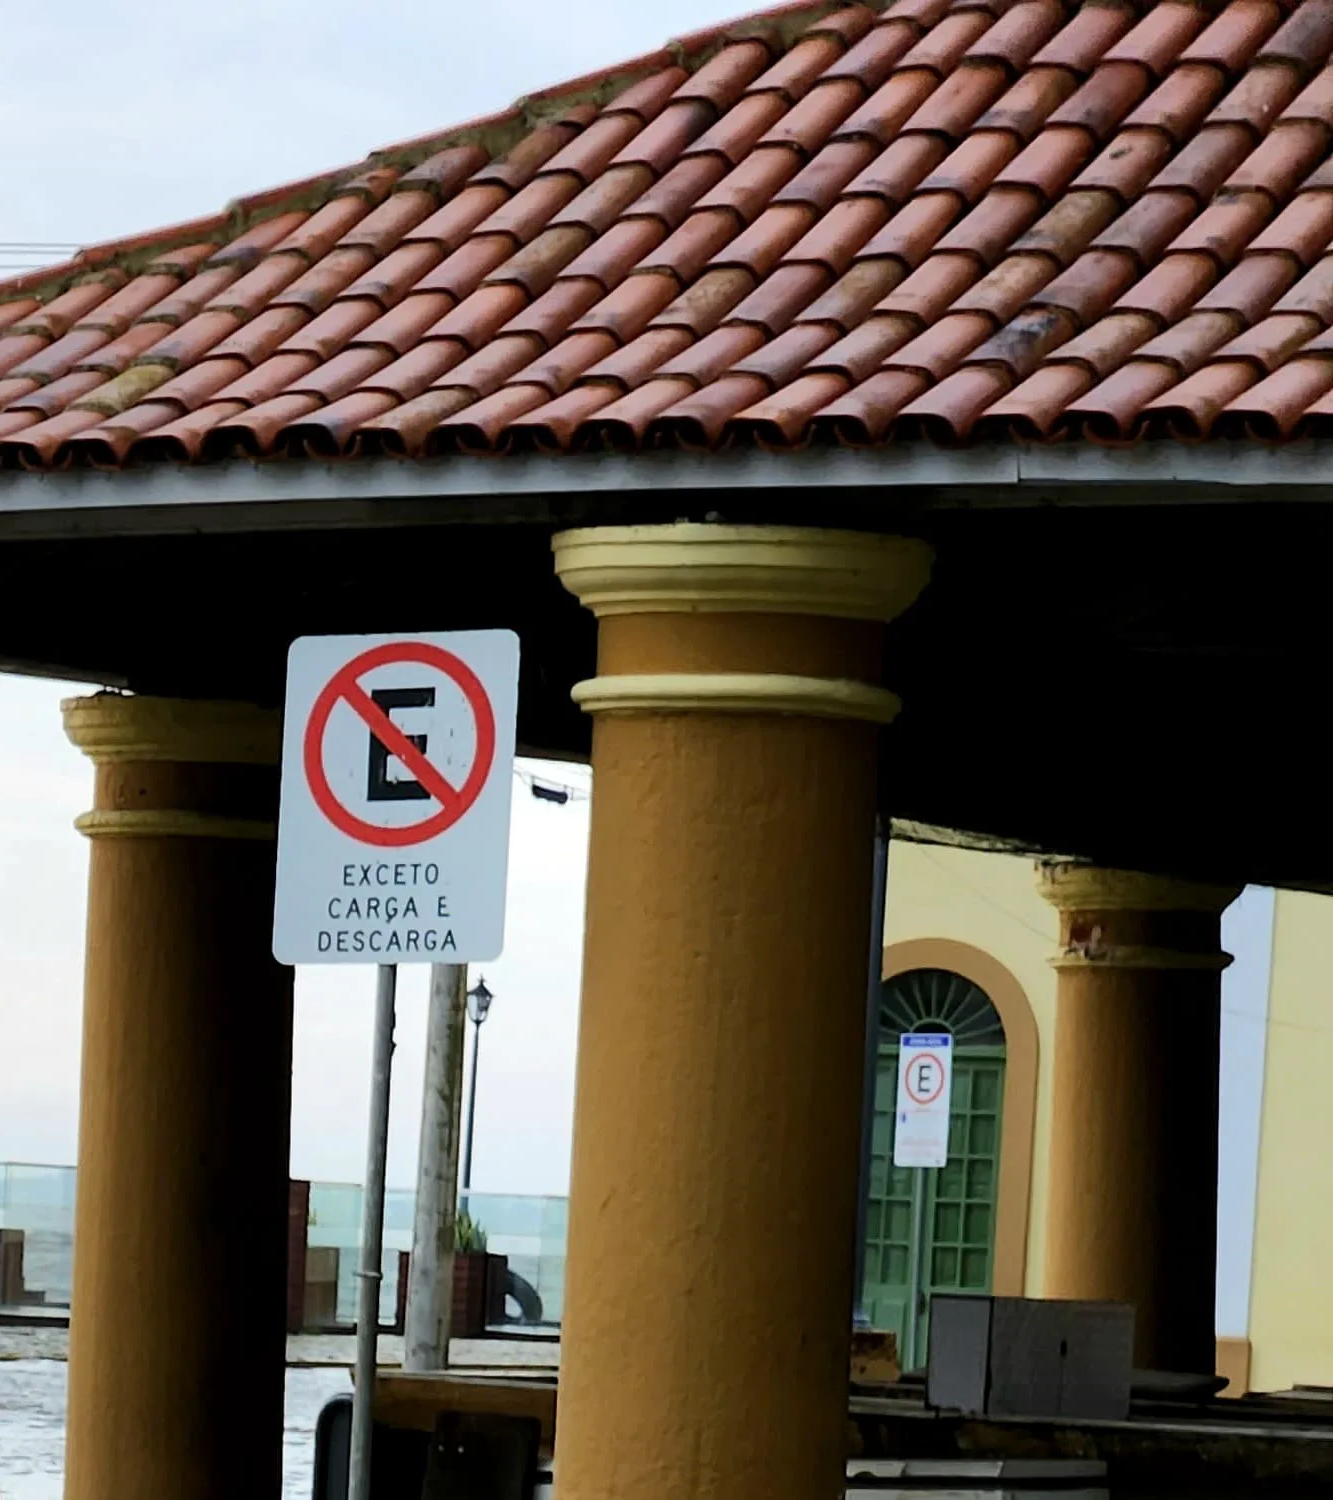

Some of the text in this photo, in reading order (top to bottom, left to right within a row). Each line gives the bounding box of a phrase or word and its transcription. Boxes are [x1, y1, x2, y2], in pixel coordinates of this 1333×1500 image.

[367, 687, 436, 802] E
[343, 863, 439, 886] EXCETO
[328, 896, 451, 924] CARGA E
[317, 929, 457, 952] DESCARGA
[917, 1064, 932, 1093] E
